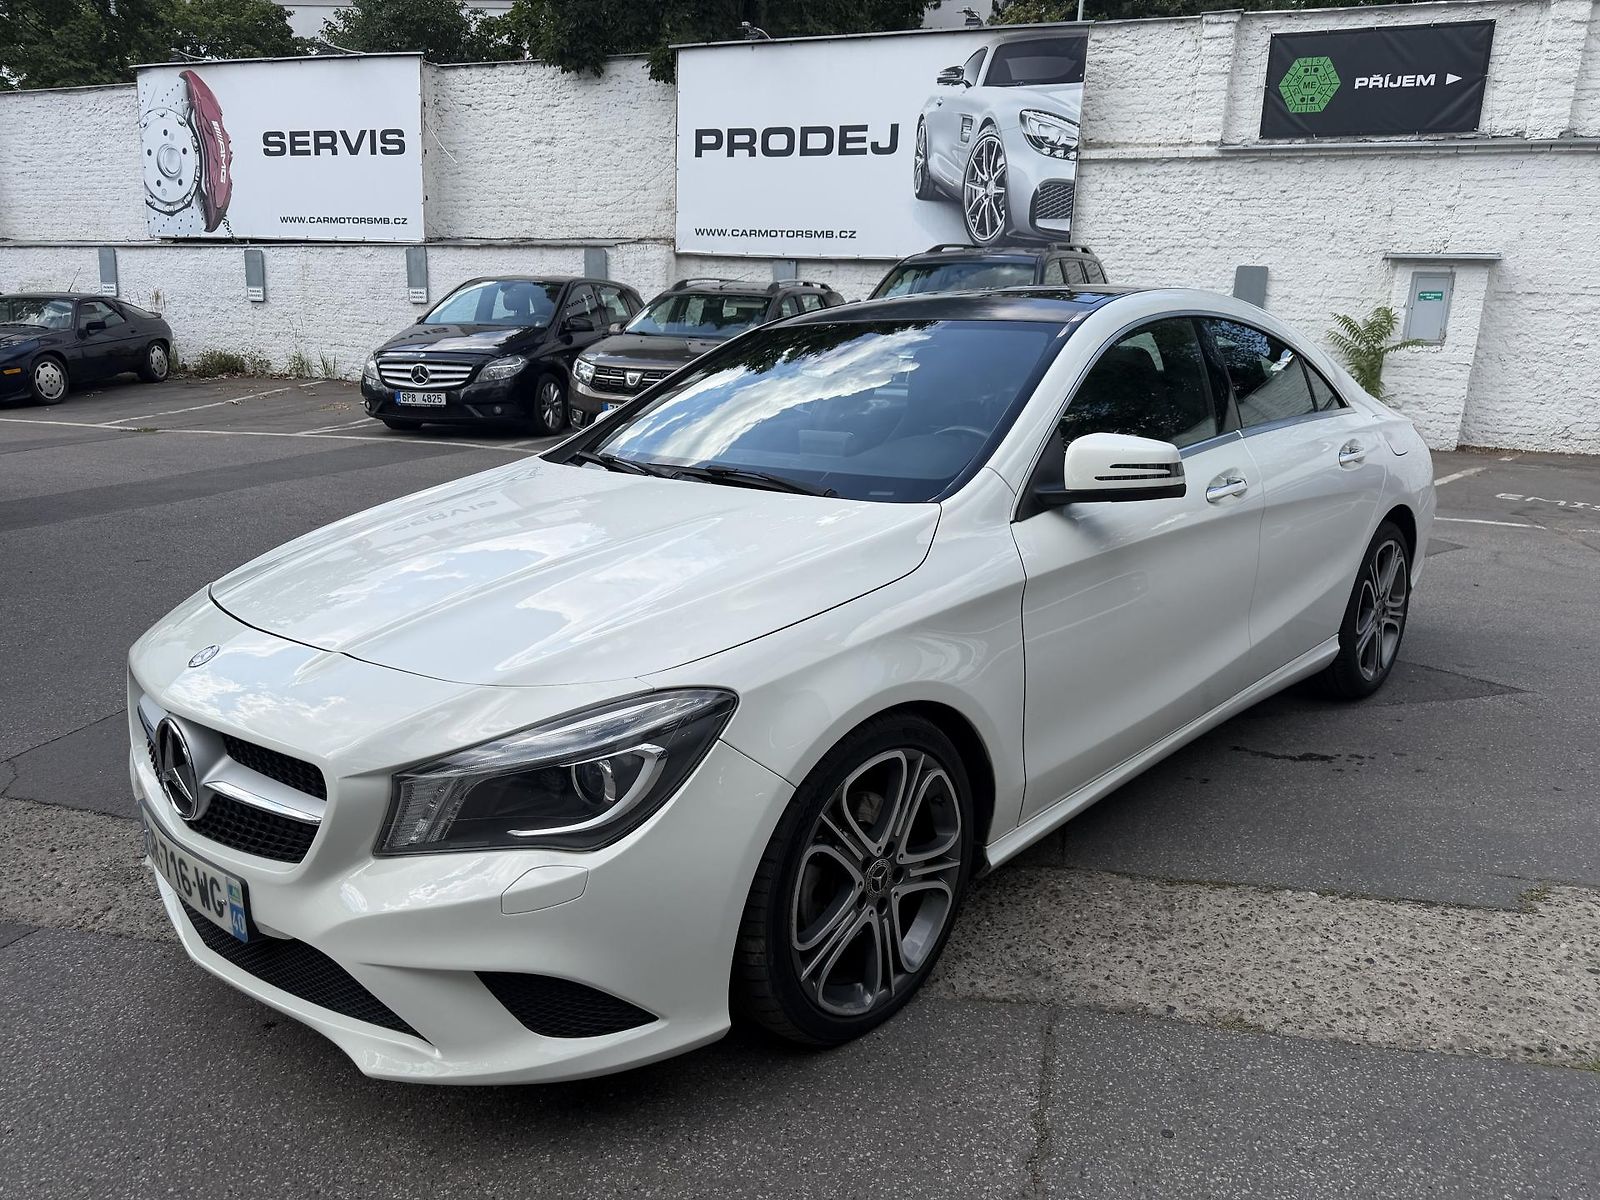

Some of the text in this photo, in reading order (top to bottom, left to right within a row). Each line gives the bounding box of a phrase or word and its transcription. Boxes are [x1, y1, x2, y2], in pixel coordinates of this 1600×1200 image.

[1302, 81, 1317, 89] ME
[1354, 73, 1436, 89] PŘÍJEM
[262, 128, 406, 157] SERVIS
[694, 123, 899, 158] PRODEJ
[279, 216, 408, 225] WWW.CARMOTORSMB.CZ
[694, 228, 857, 239] WWW.CARMOTORSMB.CZ
[402, 393, 443, 404] 6P8 4825
[232, 911, 245, 933] 40
